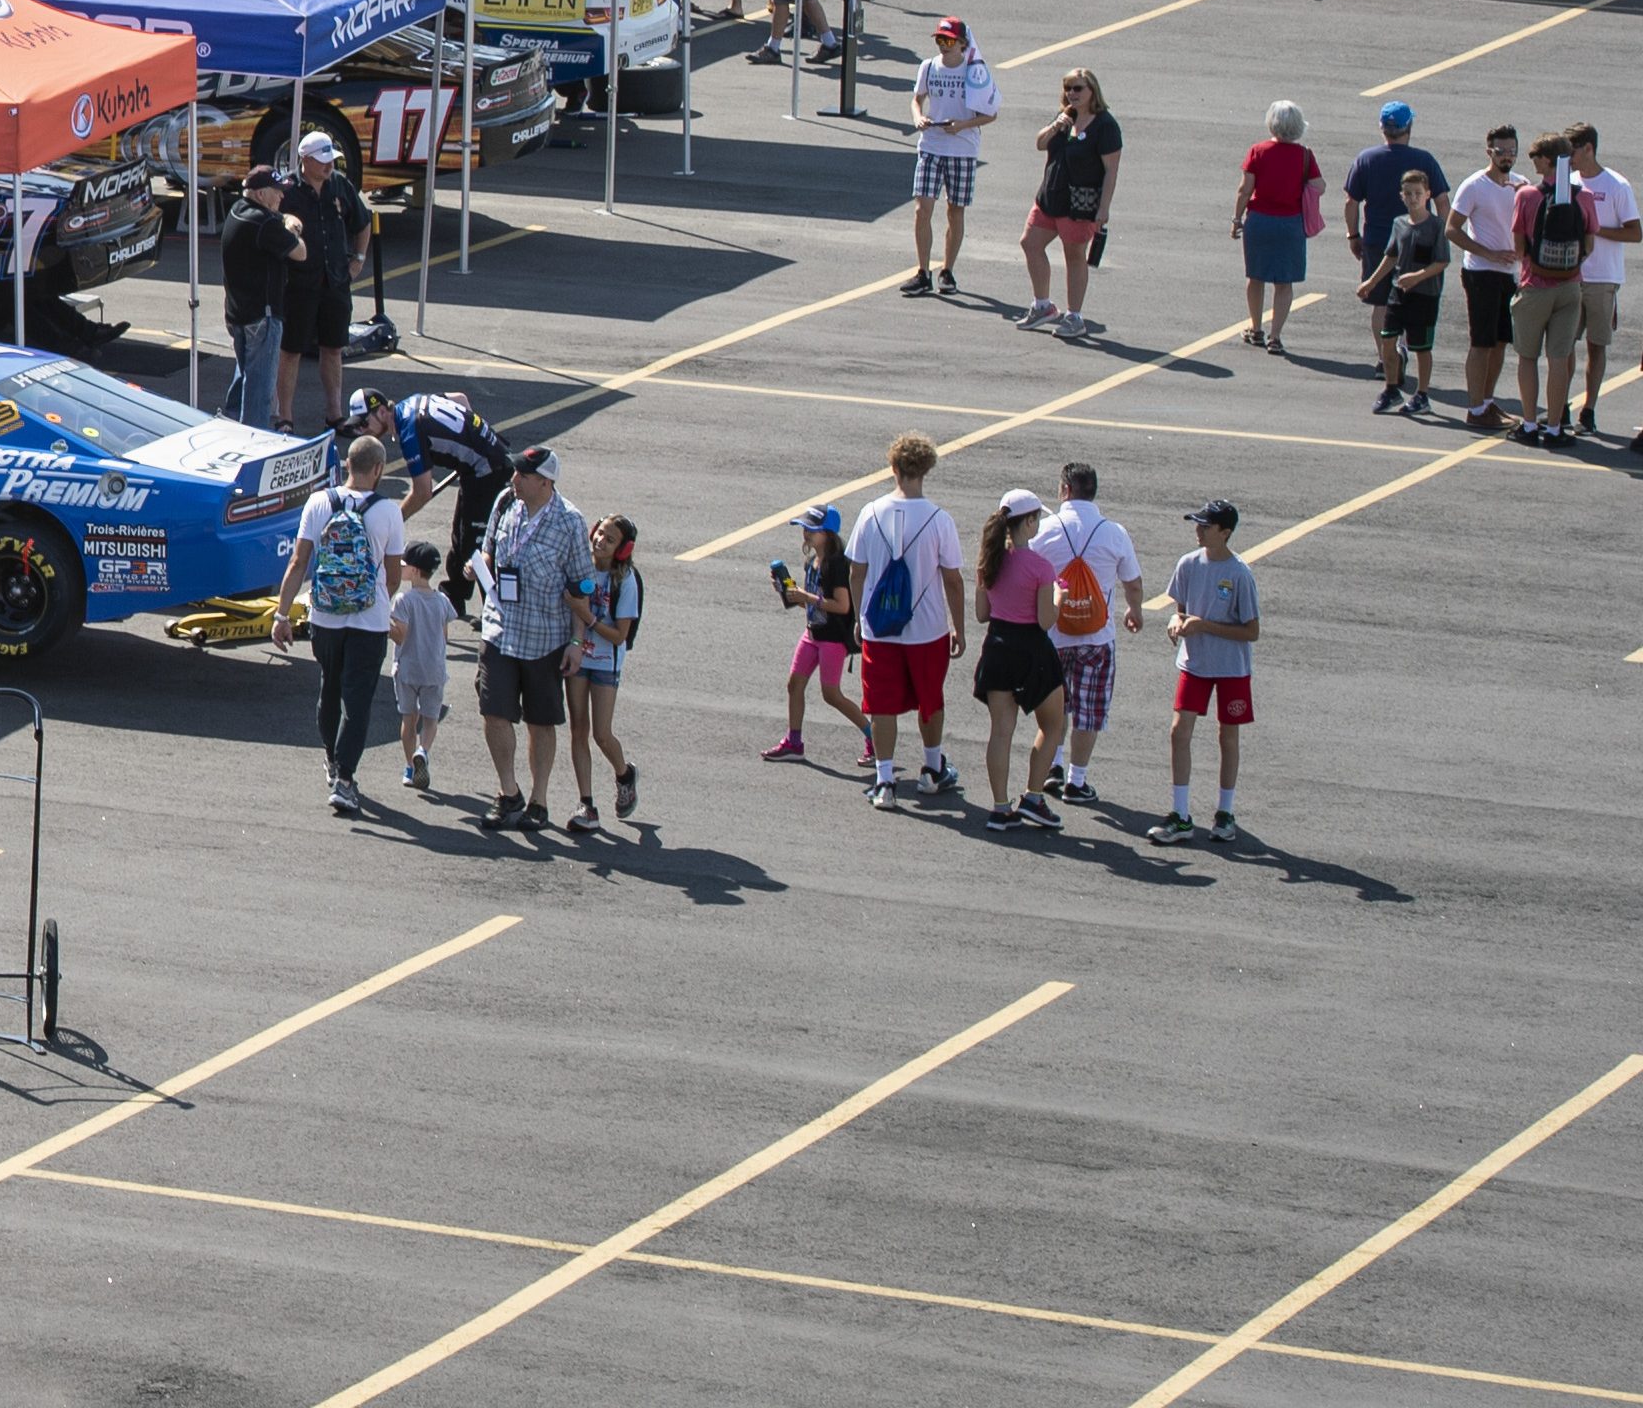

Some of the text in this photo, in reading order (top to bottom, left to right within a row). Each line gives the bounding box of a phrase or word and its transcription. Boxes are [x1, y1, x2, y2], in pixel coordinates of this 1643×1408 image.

[633, 33, 669, 53] CAMARO
[97, 78, 151, 124] Kubota
[372, 89, 457, 164] 17
[512, 122, 550, 144] CHALLENGER
[83, 161, 148, 205] MOPAR
[108, 236, 157, 265] CHALLENGER
[273, 452, 316, 474] BERNIER
[86, 522, 166, 538] Trois-Rivières
[84, 541, 166, 559] MITSUBISHI
[207, 623, 265, 638] DAYTONA
